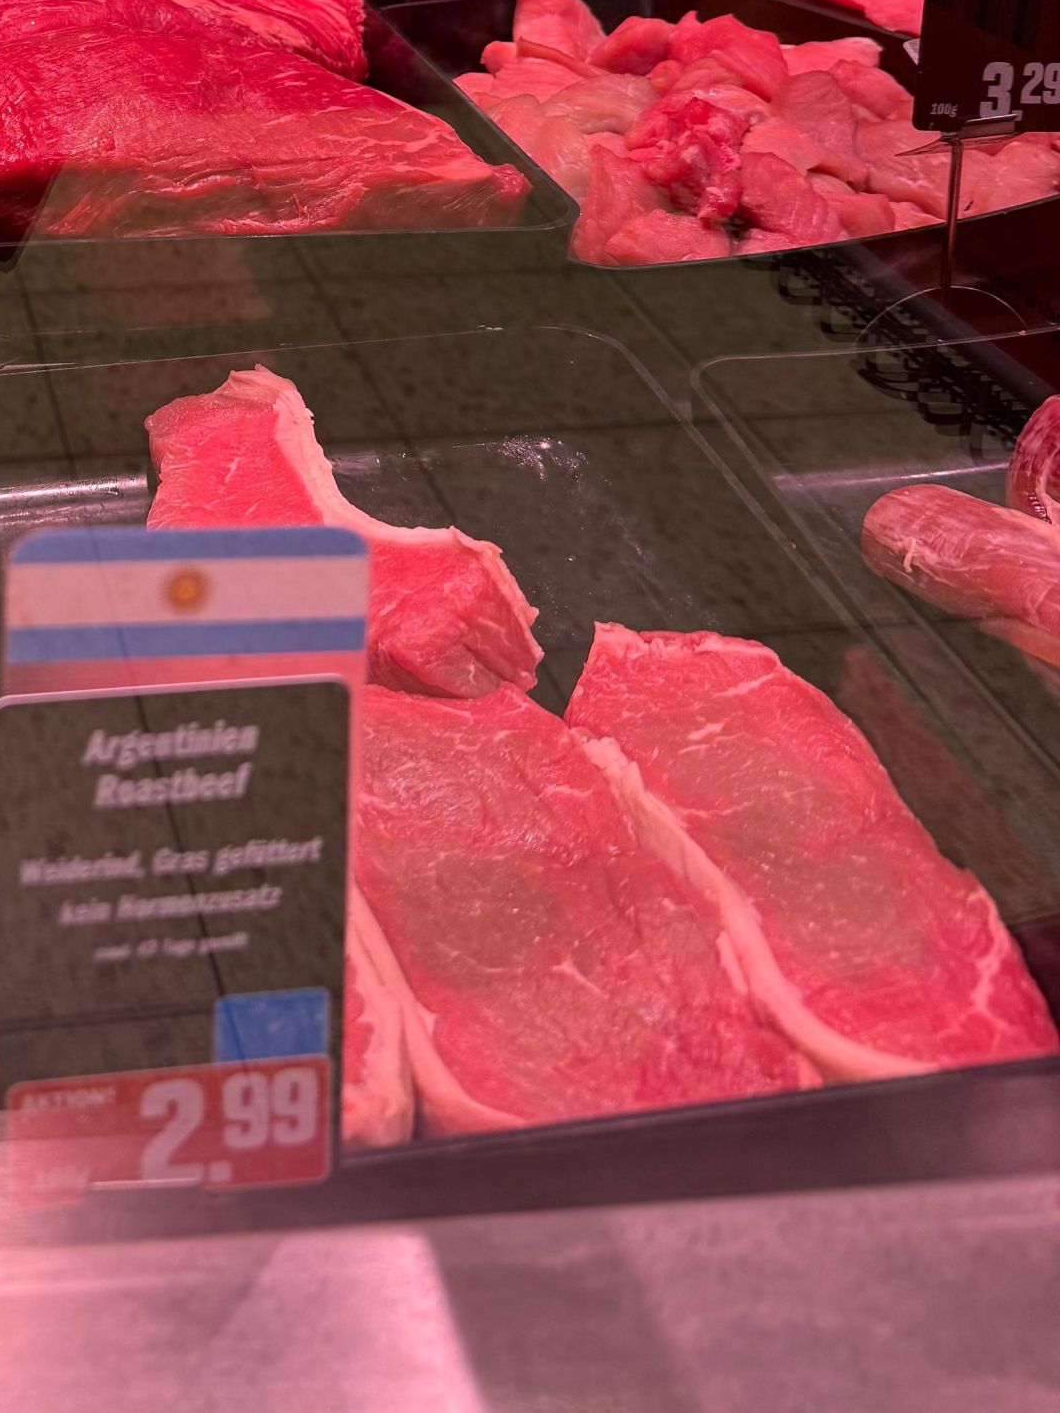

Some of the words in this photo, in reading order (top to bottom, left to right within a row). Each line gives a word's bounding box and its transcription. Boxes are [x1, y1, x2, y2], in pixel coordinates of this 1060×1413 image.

[930, 102, 958, 118] 100g
[84, 722, 258, 767] Argentinien
[94, 762, 253, 809] Roastbeef
[140, 1067, 319, 1184] 2.99
